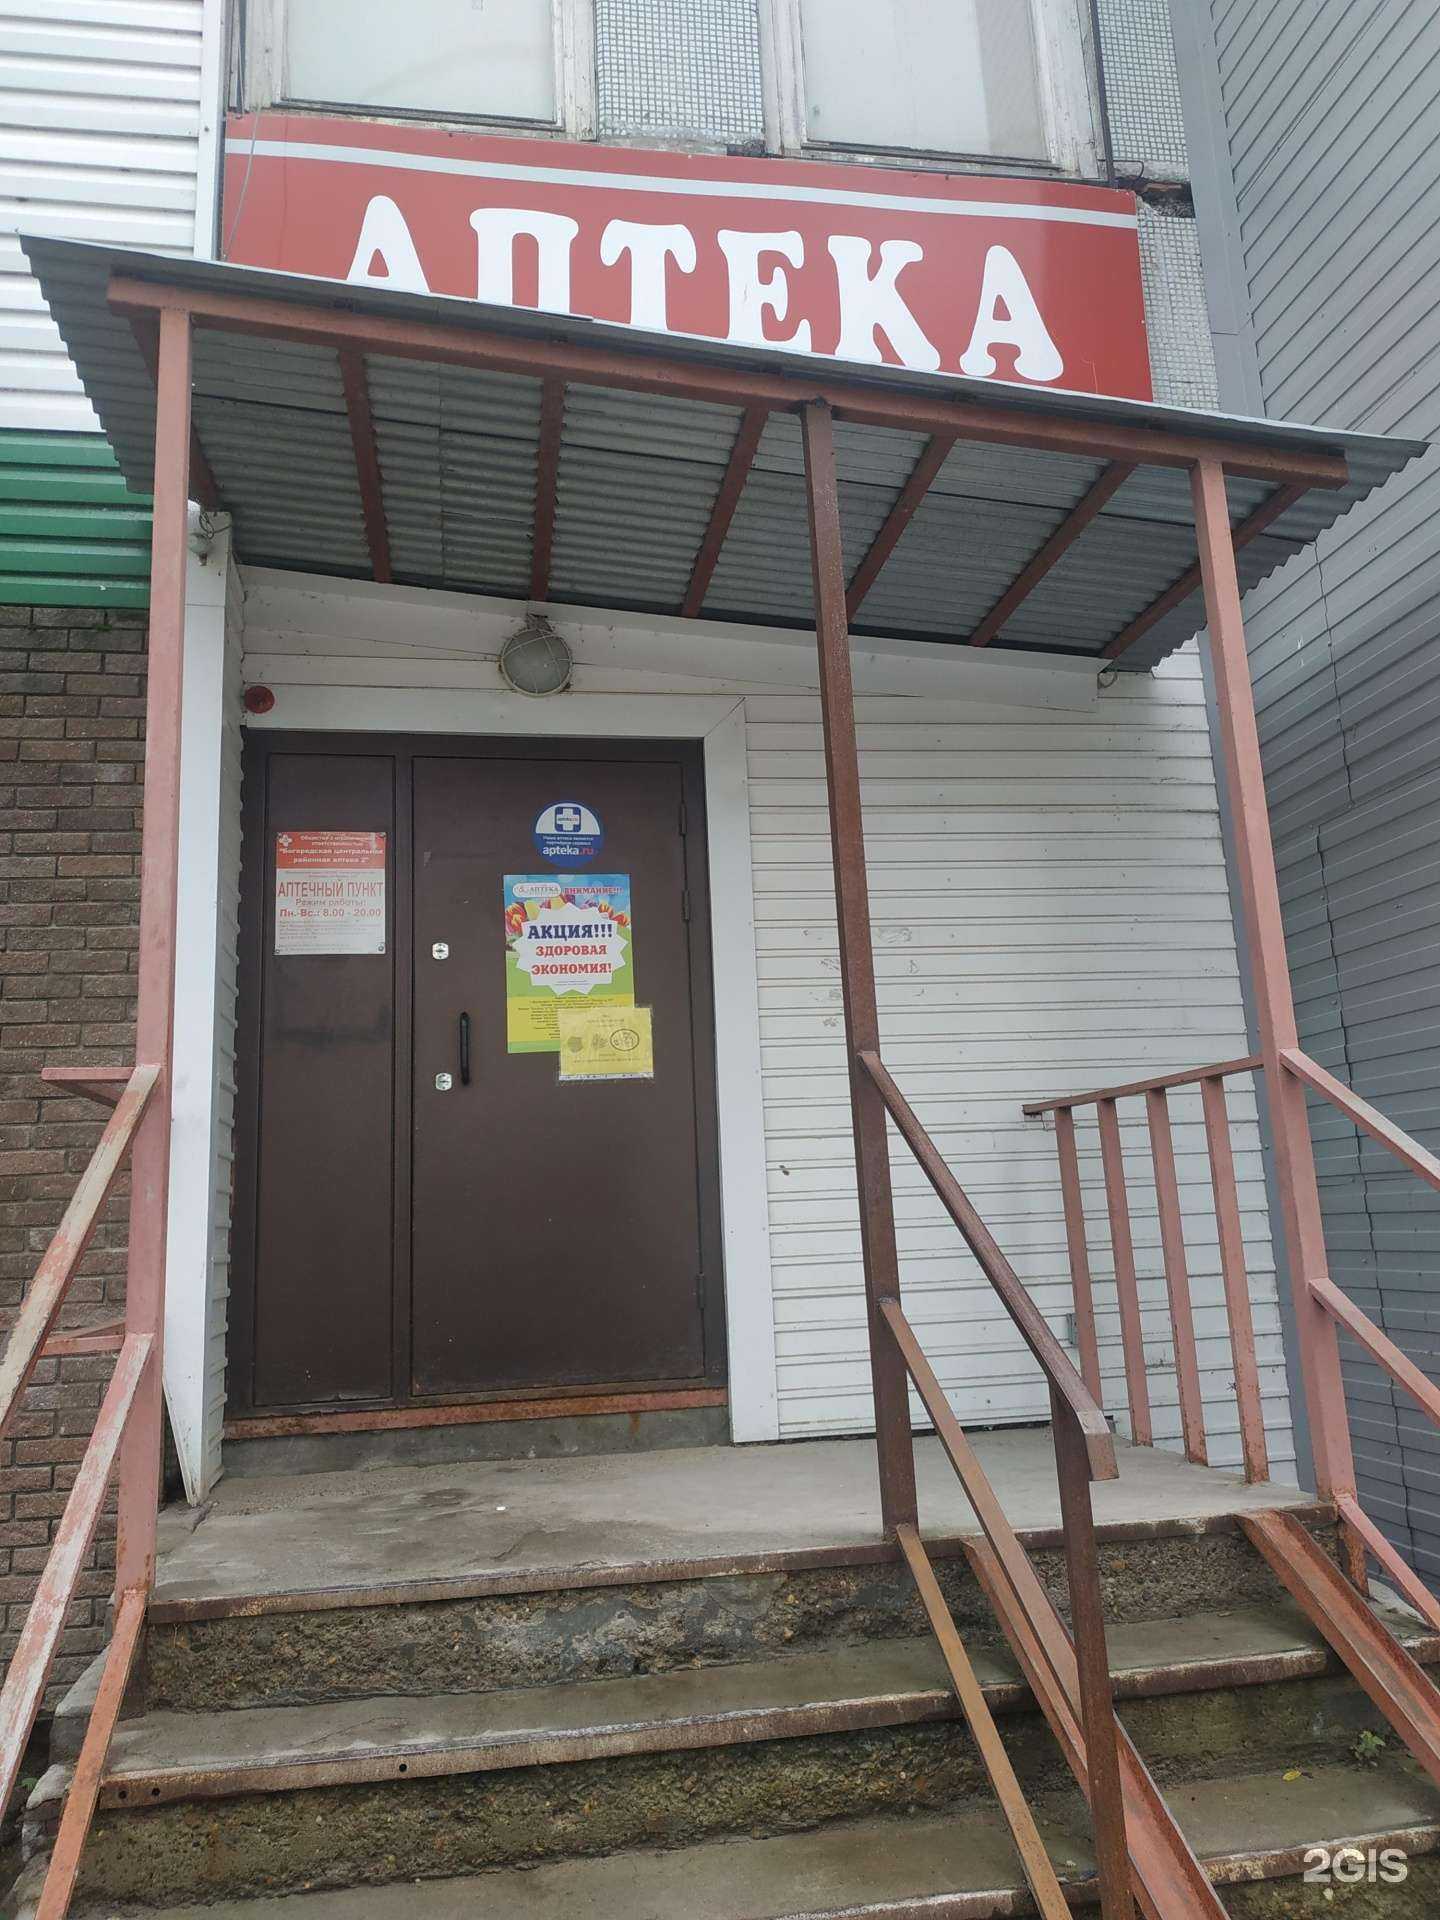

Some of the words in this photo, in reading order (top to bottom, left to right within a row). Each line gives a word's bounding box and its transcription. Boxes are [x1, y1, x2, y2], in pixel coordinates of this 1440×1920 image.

[345, 195, 1064, 382] АПТЕКА
[542, 845, 594, 857] apteka.ru
[277, 879, 344, 897] АПТЕЧНЫЙ
[347, 882, 384, 897] ПУНКТ
[352, 908, 382, 917] 20.00
[527, 924, 613, 942] АКЦИЯ!!!
[535, 944, 607, 957] ЗДОРОВАЯ
[531, 962, 612, 976] ЭКОНОМИЯ!
